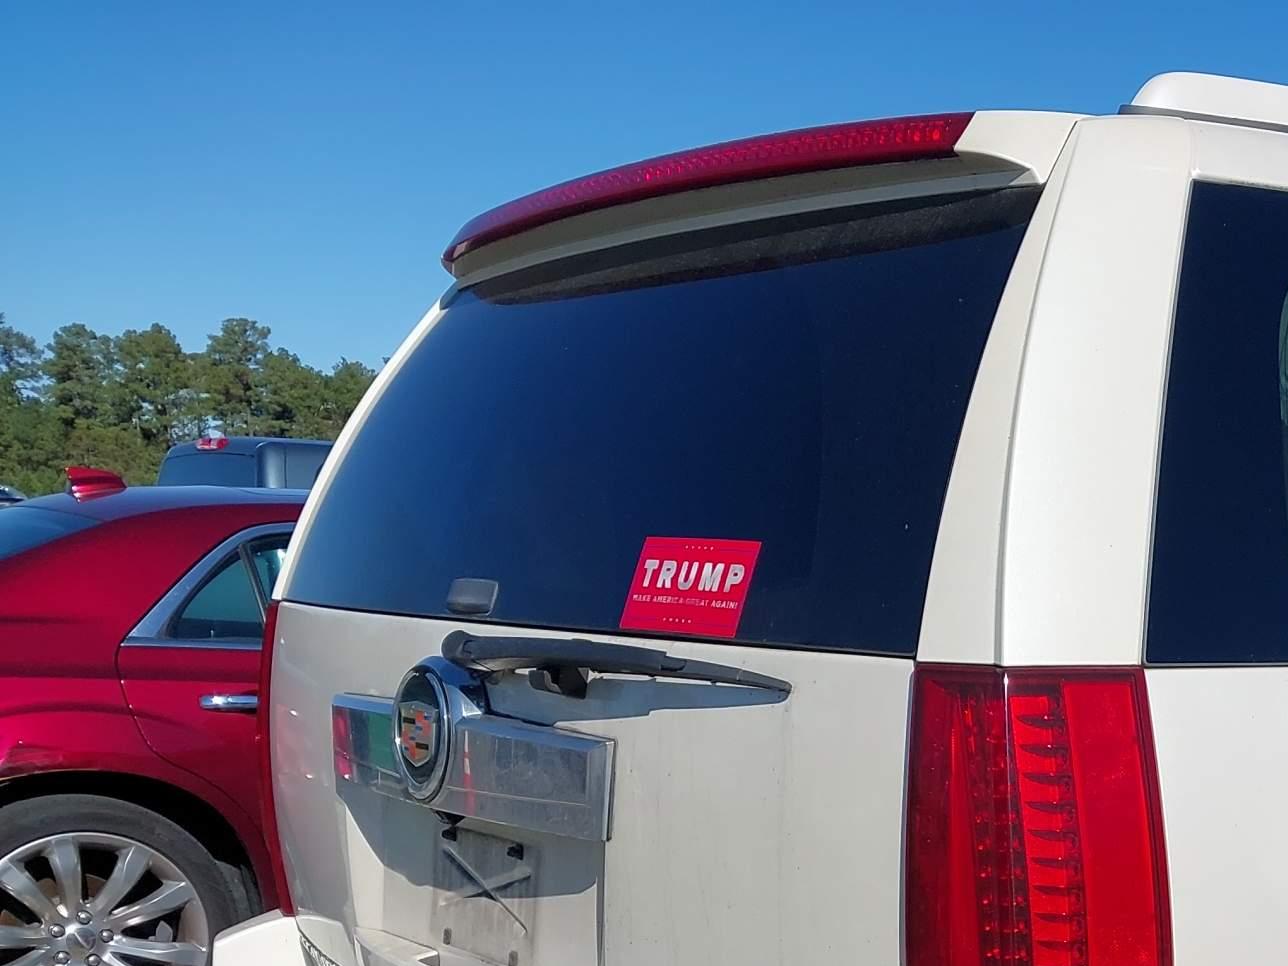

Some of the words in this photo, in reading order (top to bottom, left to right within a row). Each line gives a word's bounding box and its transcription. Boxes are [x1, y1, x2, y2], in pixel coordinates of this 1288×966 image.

[641, 559, 745, 593] TRUMP
[632, 594, 652, 603] MAKE
[710, 600, 738, 610] AGAIN!
